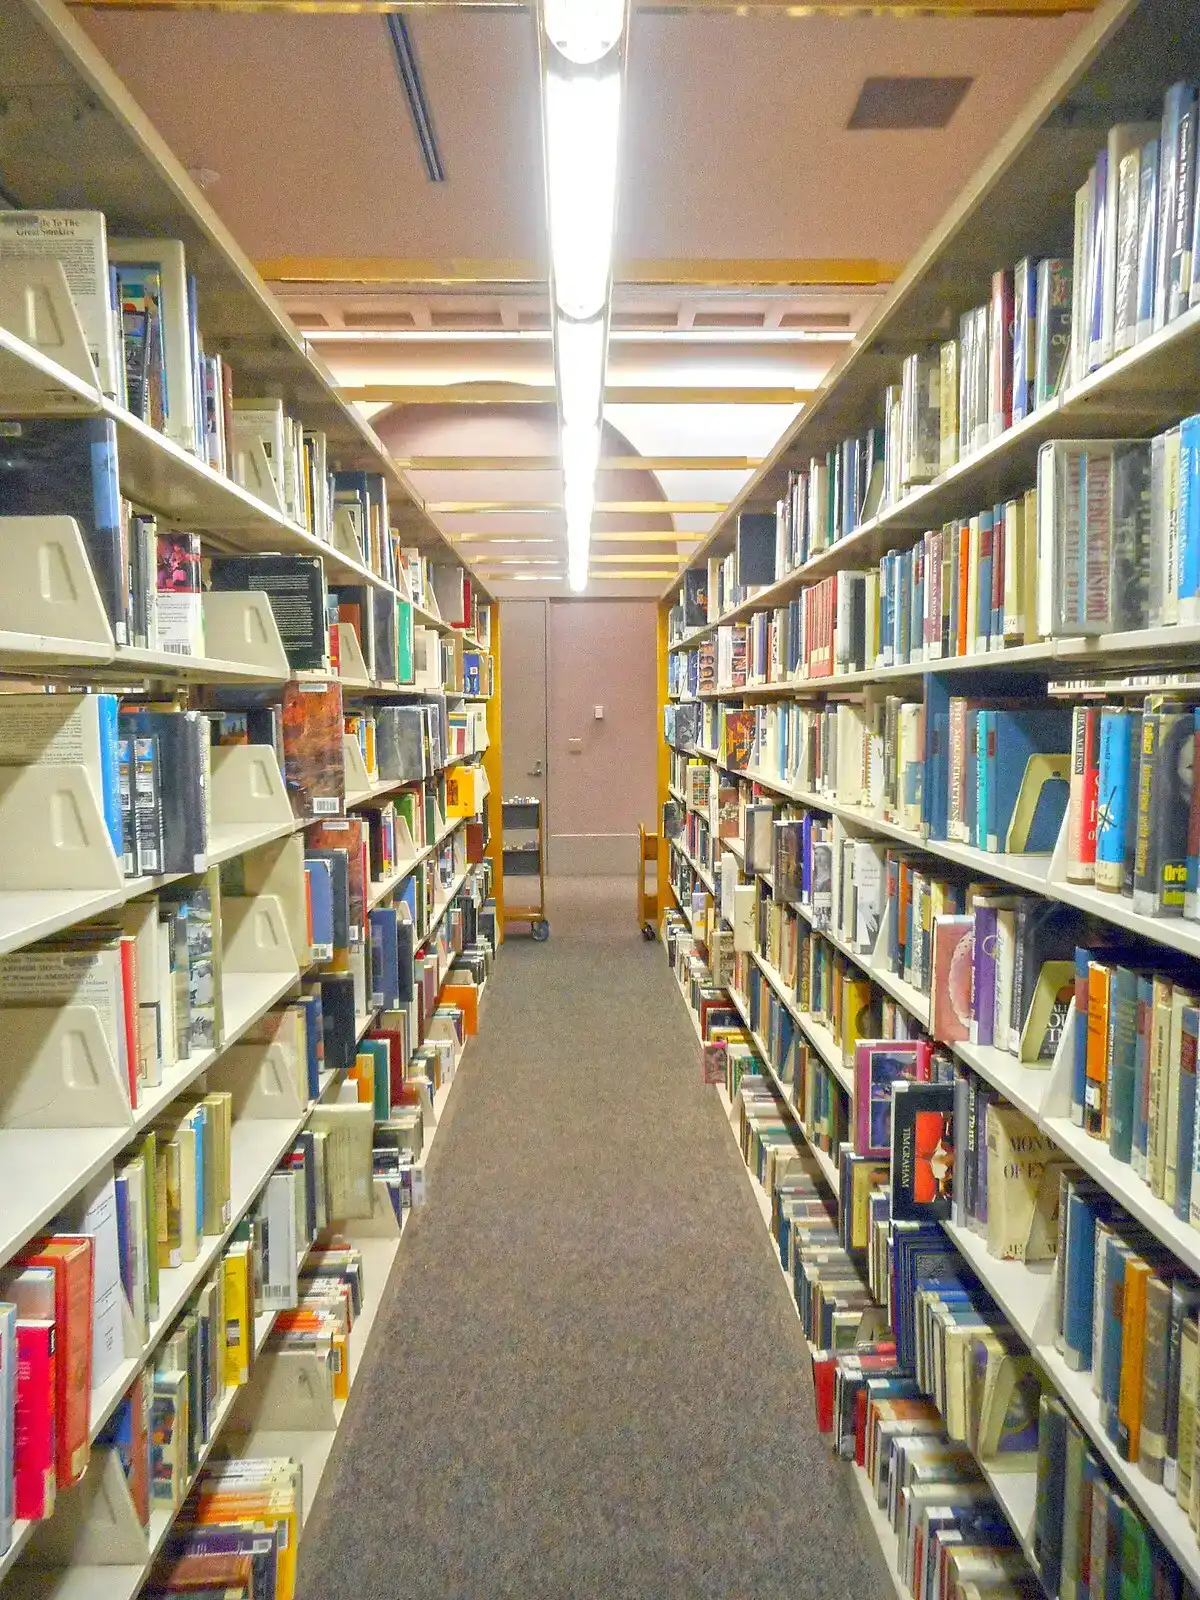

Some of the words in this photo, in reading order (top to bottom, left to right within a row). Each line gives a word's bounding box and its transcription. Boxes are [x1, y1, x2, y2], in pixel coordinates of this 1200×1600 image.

[1178, 173, 1186, 190] The
[1177, 191, 1187, 220] White
[64, 217, 81, 228] The
[1179, 456, 1190, 492] White
[1178, 493, 1189, 534] House
[931, 559, 939, 597] AMERICAN
[1086, 561, 1110, 623] HISTORY
[953, 701, 963, 725] THE
[1076, 713, 1086, 735] DEAN
[1104, 736, 1112, 760] world
[1143, 722, 1155, 755] Fallaci
[1075, 736, 1085, 774] ACHESON
[1140, 764, 1153, 812] Interview
[1138, 815, 1151, 838] with
[1164, 864, 1187, 882] Oria
[902, 1127, 911, 1145] TIM
[901, 1145, 911, 1188] GRAHAM
[1003, 1163, 1019, 1178] OF
